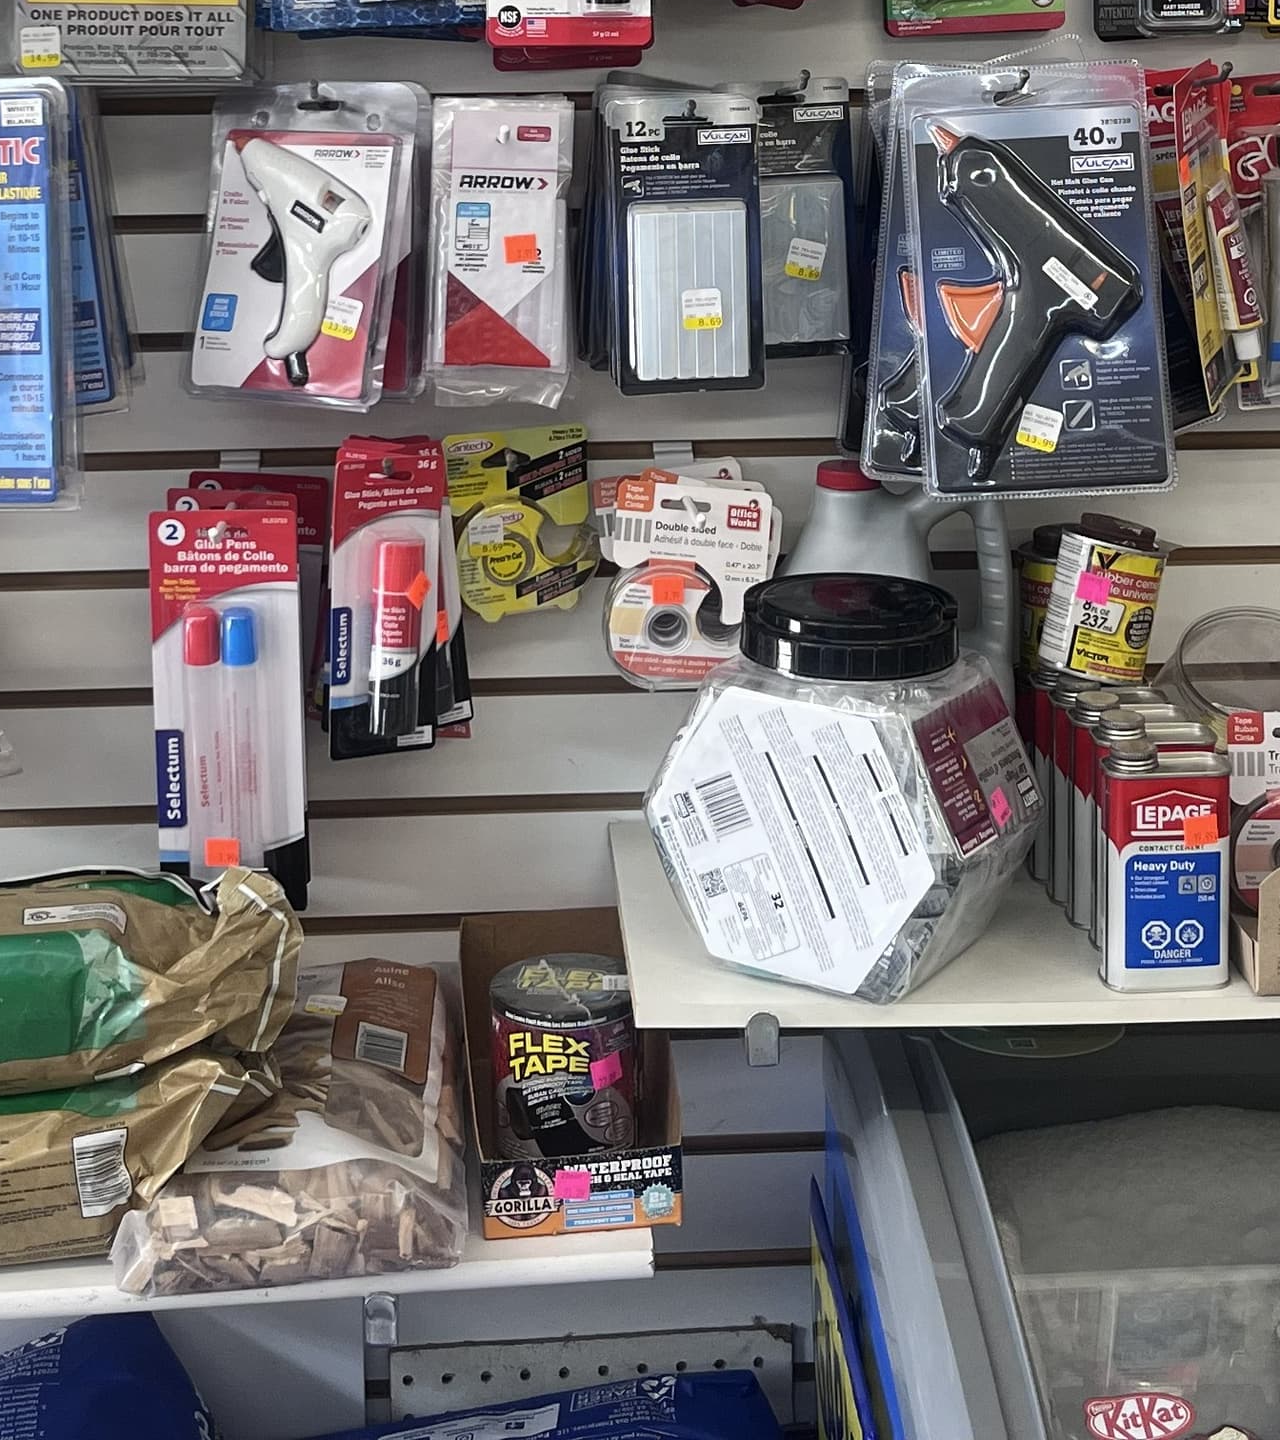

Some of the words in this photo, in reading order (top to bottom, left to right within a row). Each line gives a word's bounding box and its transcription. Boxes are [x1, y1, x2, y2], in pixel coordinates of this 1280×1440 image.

[31, 10, 62, 20] ONE
[67, 10, 139, 21] PRODUCT
[144, 11, 183, 22] DOES
[189, 12, 203, 22] IT
[207, 12, 234, 23] ALL
[459, 176, 533, 192] ARROW
[226, 540, 256, 549] Pens
[177, 551, 221, 561] Bâtons
[224, 551, 239, 561] de
[243, 551, 274, 561] Colle
[164, 563, 197, 573] barra
[200, 563, 216, 572] de
[219, 563, 288, 574] pegamento
[165, 738, 182, 820] Selectum
[1136, 801, 1212, 830] LEPAGE
[1133, 859, 1165, 873] Heavy
[1168, 860, 1195, 873] Duty
[1153, 948, 1191, 959] DANGER
[508, 1032, 590, 1056] FLEX
[508, 1054, 590, 1078] TAPE
